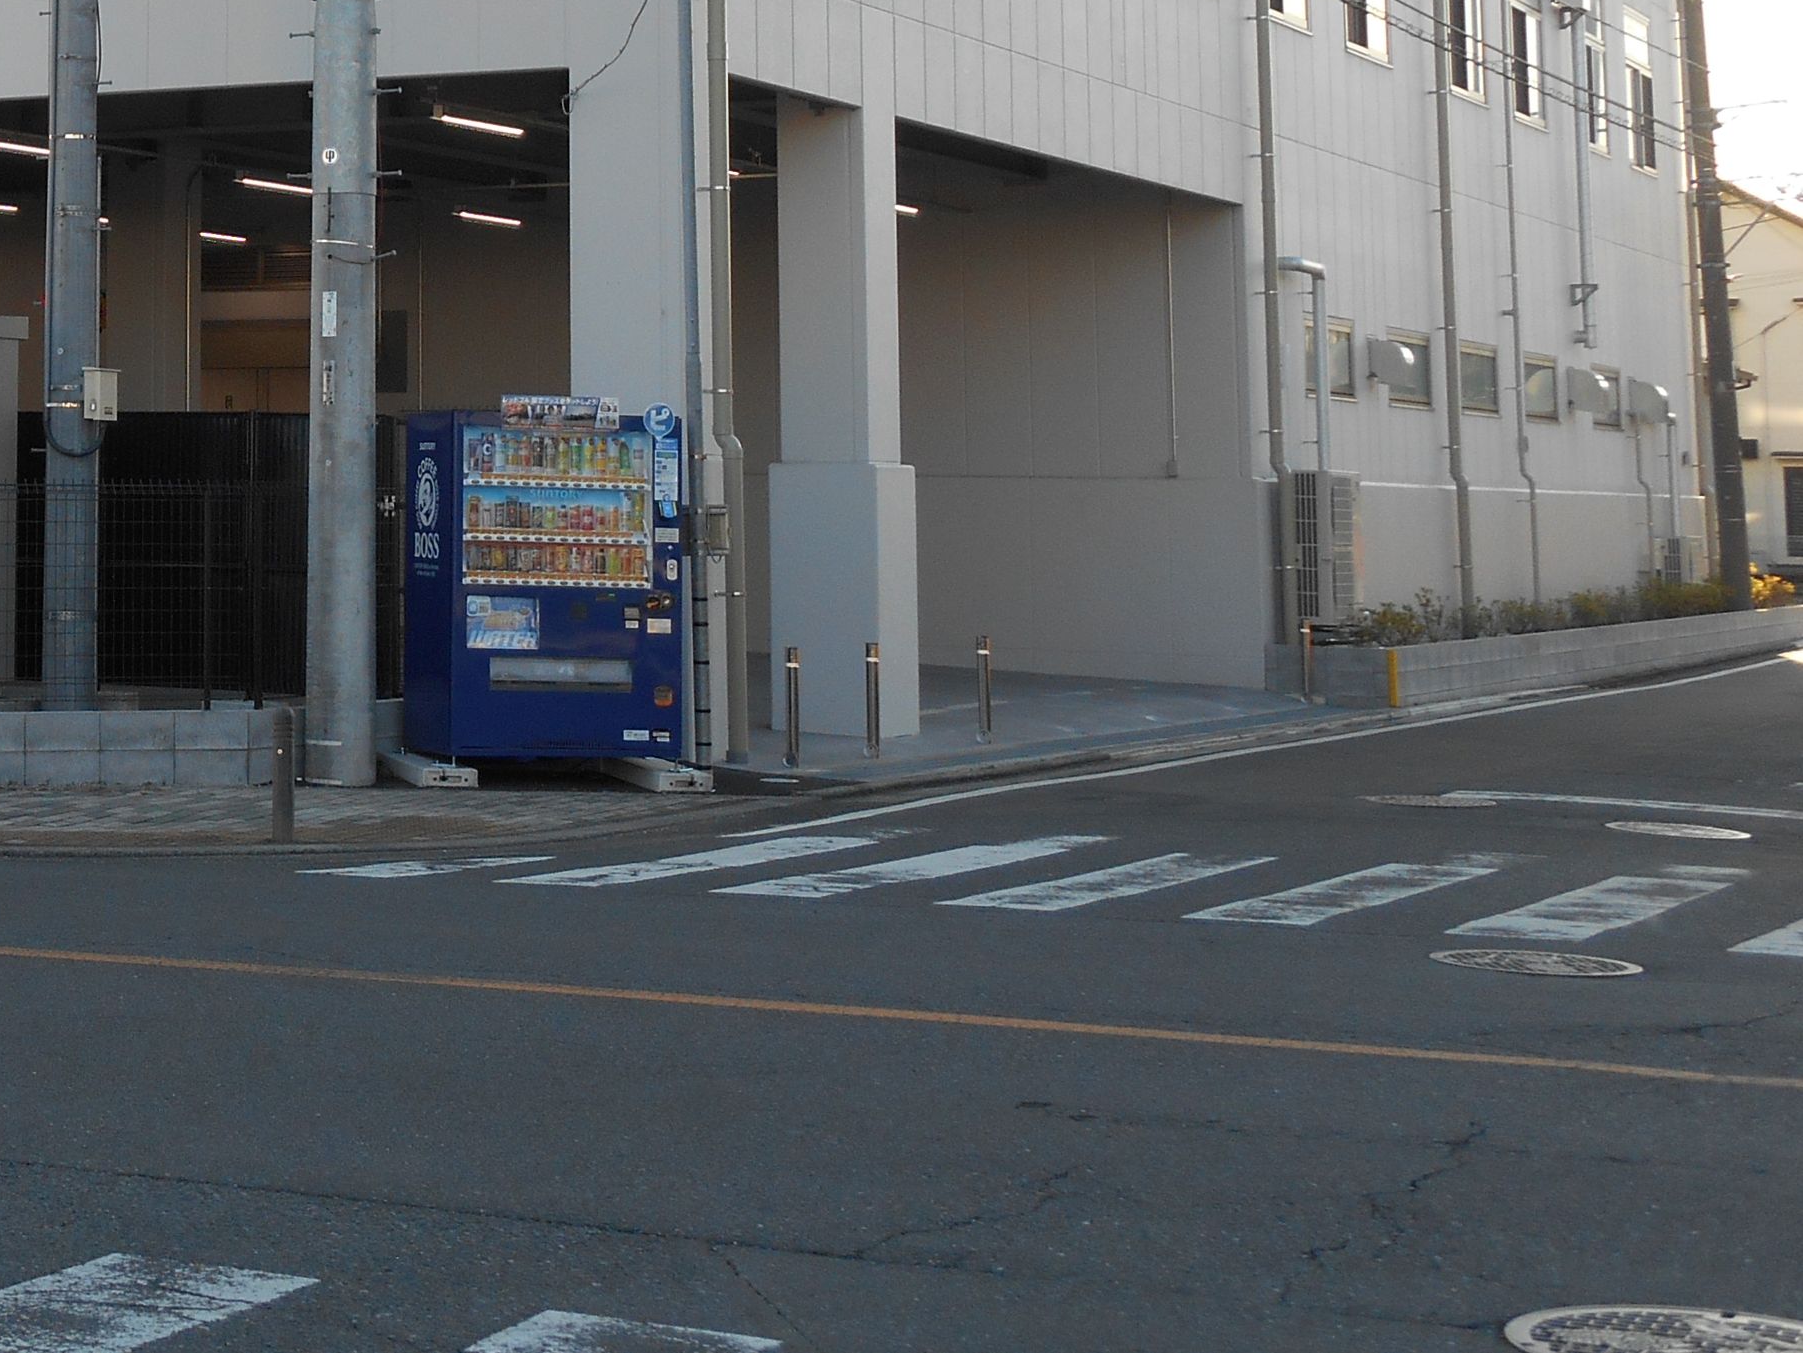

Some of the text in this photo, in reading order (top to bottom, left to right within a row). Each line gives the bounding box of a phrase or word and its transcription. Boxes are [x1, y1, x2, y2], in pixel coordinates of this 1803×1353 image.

[417, 457, 437, 479] COFFEE
[530, 488, 583, 500] SUNTORY
[414, 532, 440, 559] BOSS
